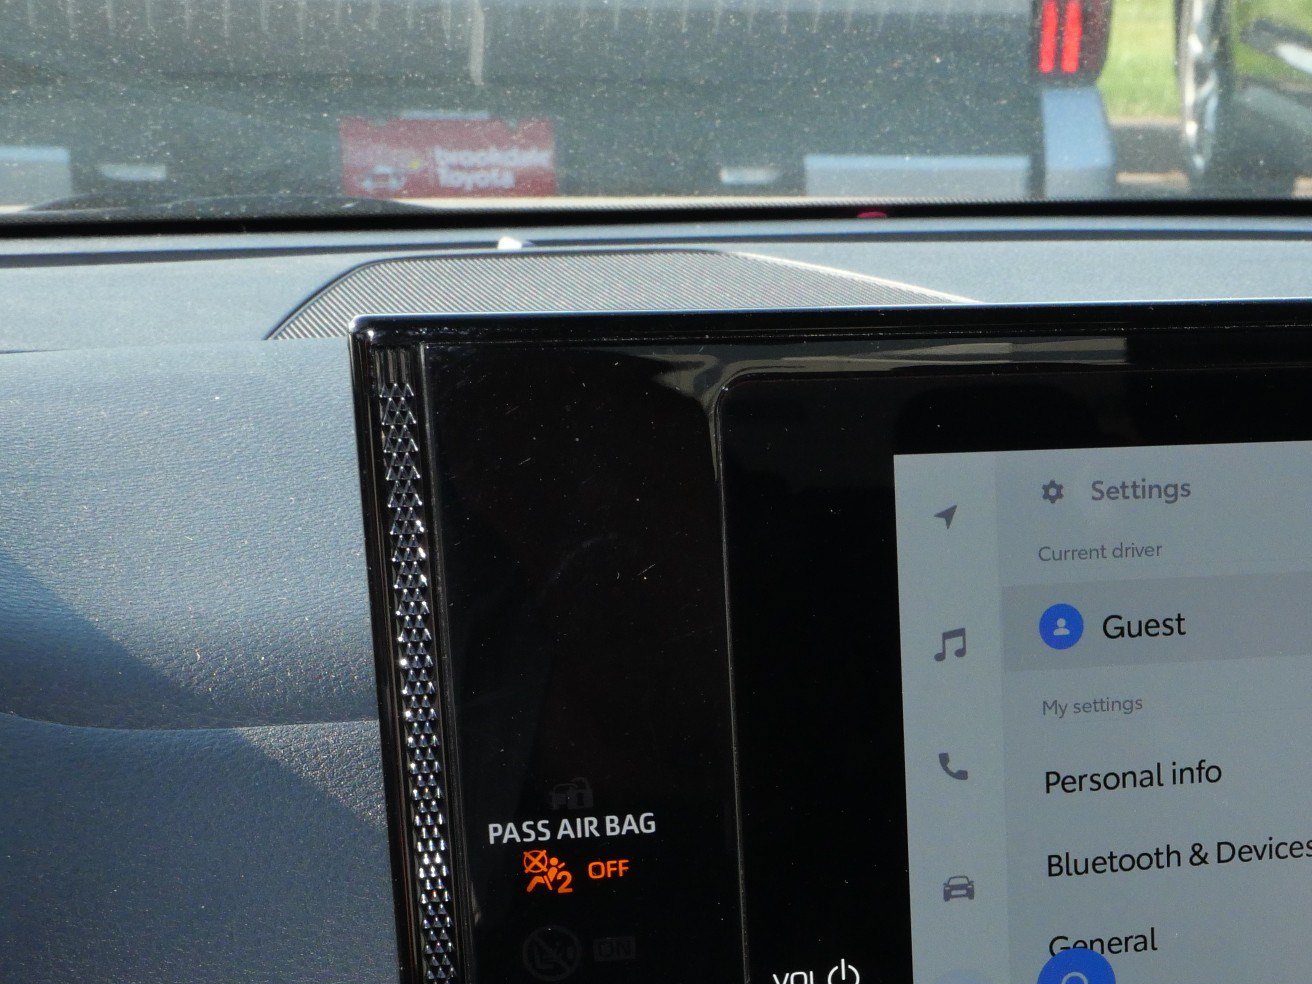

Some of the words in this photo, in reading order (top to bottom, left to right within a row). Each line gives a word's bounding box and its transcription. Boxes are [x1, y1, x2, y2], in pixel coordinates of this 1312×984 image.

[1091, 478, 1191, 504] Settings
[1038, 544, 1107, 562] Current
[1112, 542, 1163, 559] driver
[1102, 613, 1187, 640] Guest
[1042, 698, 1067, 719] My
[1073, 697, 1143, 717] settings
[1045, 763, 1164, 794] Personal
[1172, 759, 1222, 786] info
[488, 820, 551, 845] PASS
[556, 816, 599, 841] AIR
[605, 812, 657, 837] BAG
[587, 859, 630, 880] OFF
[1048, 844, 1182, 877] Bluetooth
[1189, 842, 1210, 866] &
